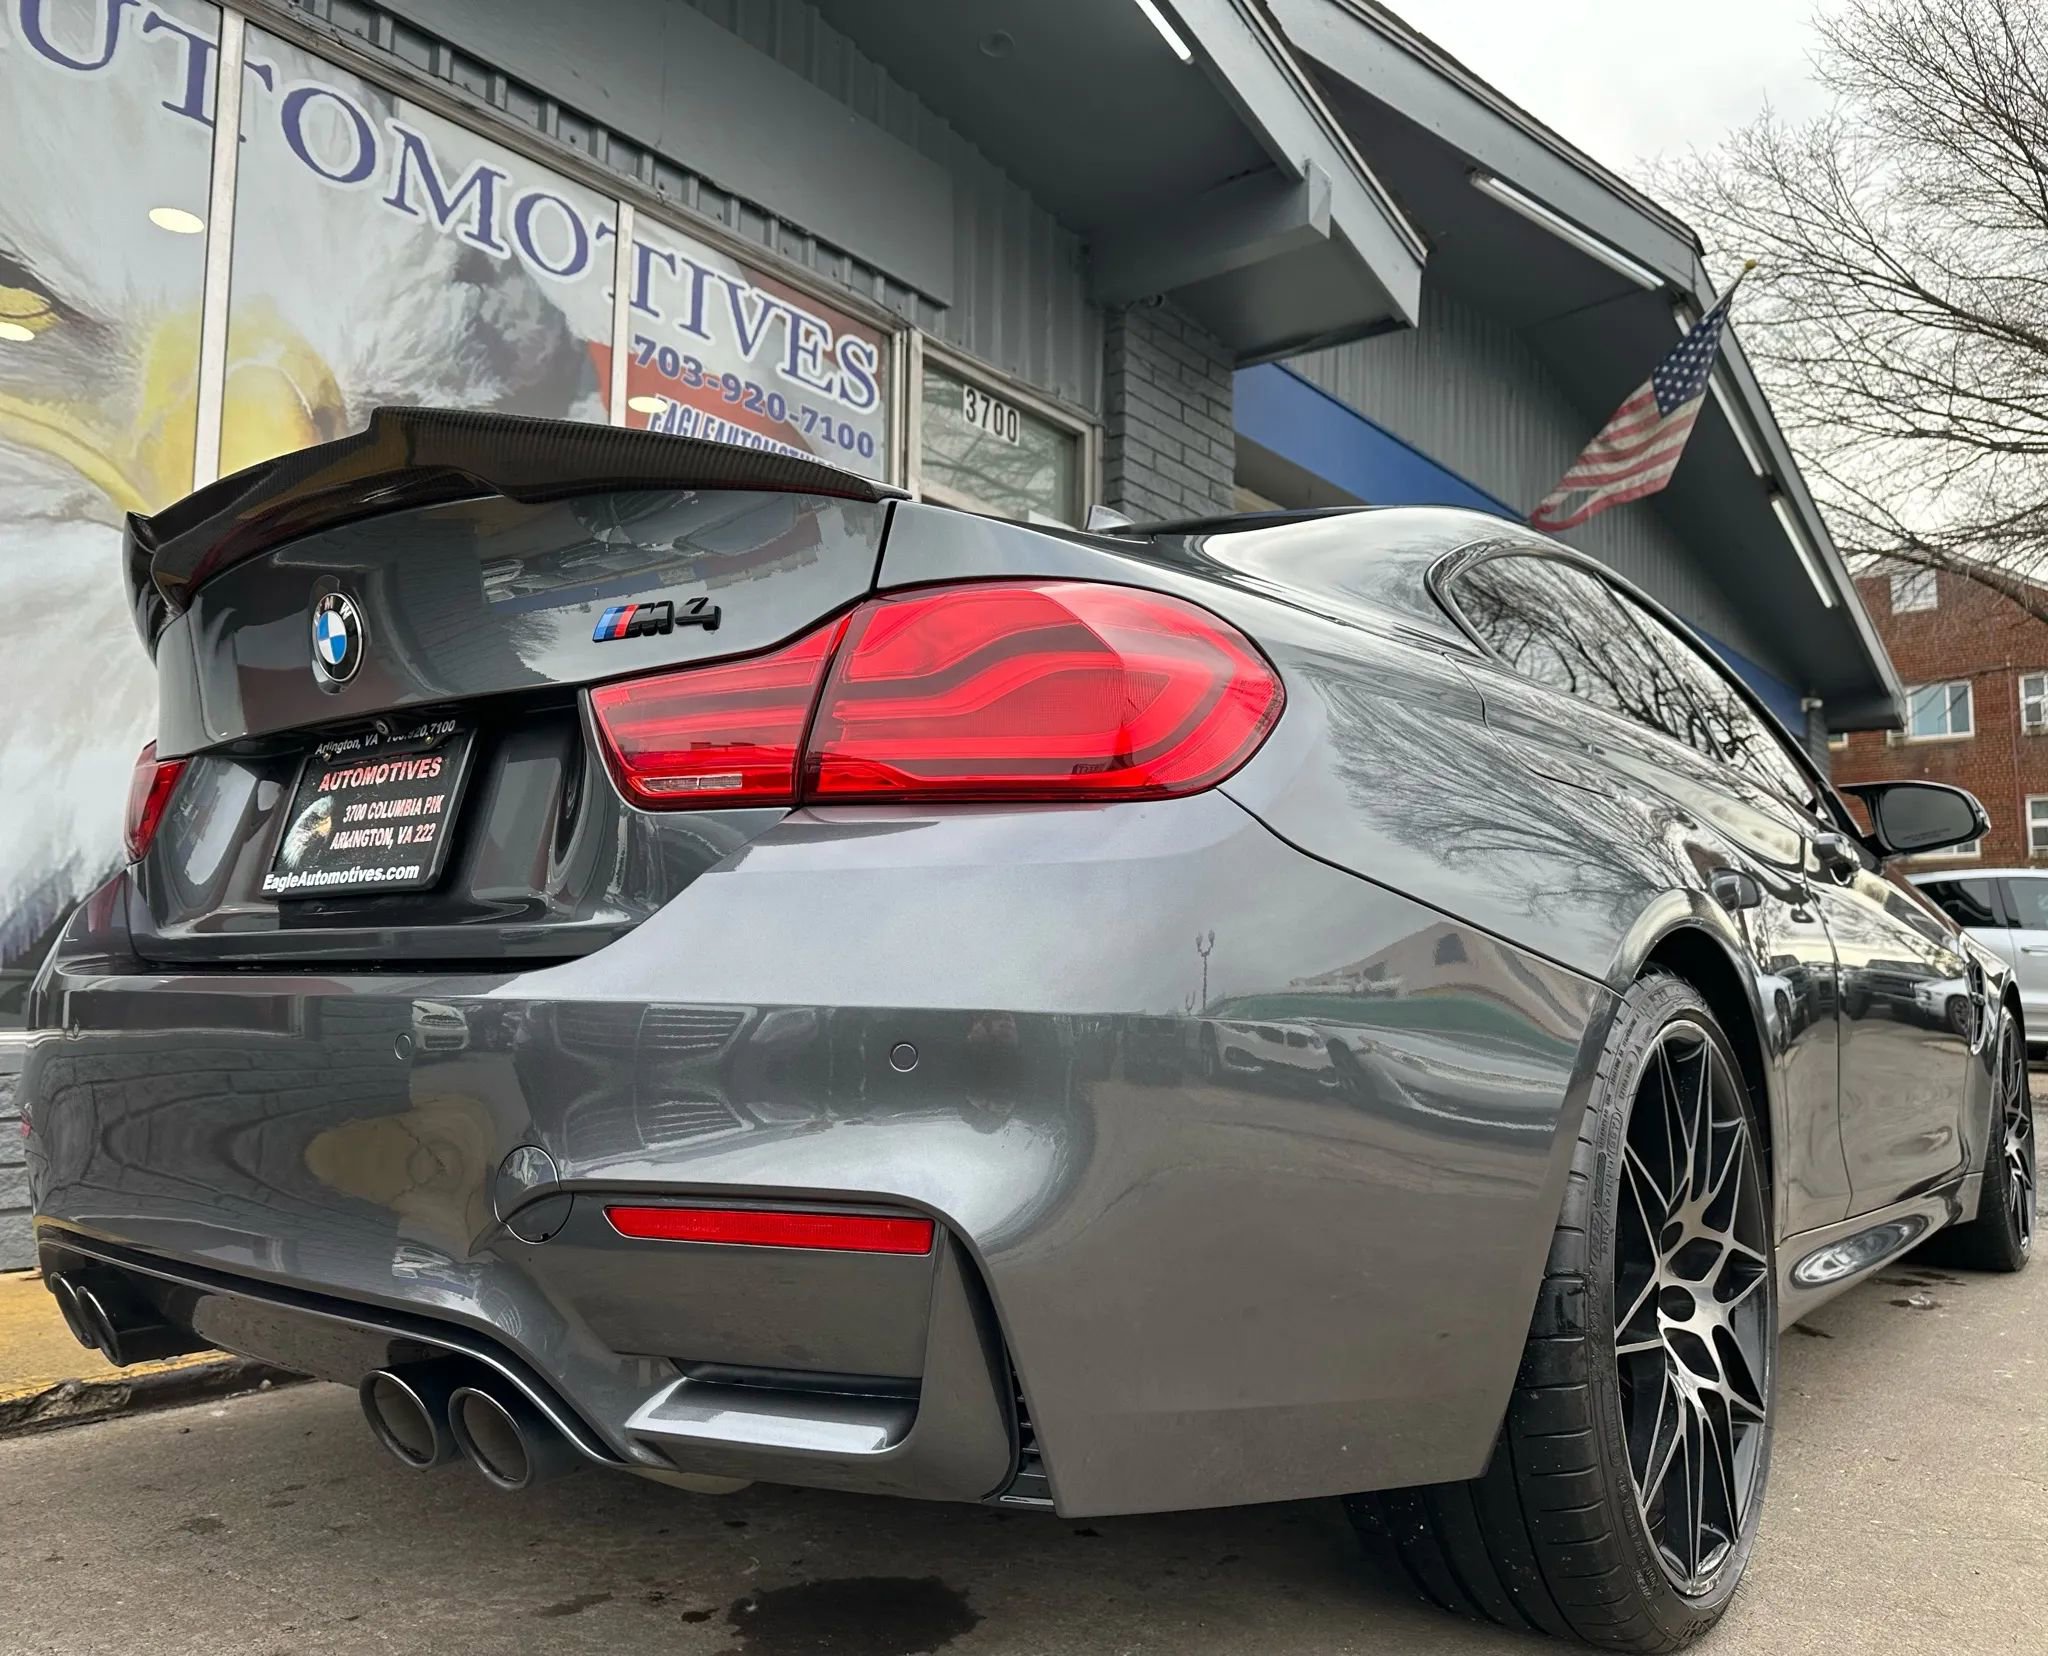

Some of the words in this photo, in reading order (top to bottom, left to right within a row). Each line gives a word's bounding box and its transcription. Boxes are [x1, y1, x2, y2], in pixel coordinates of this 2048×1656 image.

[634, 334, 874, 459] 703-920-7100
[965, 389, 1018, 443] 3700
[365, 733, 379, 747] VA
[318, 756, 443, 792] AUTOMOTIVES
[343, 803, 369, 824] 3700
[367, 797, 423, 820] COLUMBIA
[329, 827, 394, 850] ARLINGTON,
[397, 825, 413, 844] VA
[413, 822, 436, 843] 222
[262, 864, 420, 892] EagleAutomotives.com
